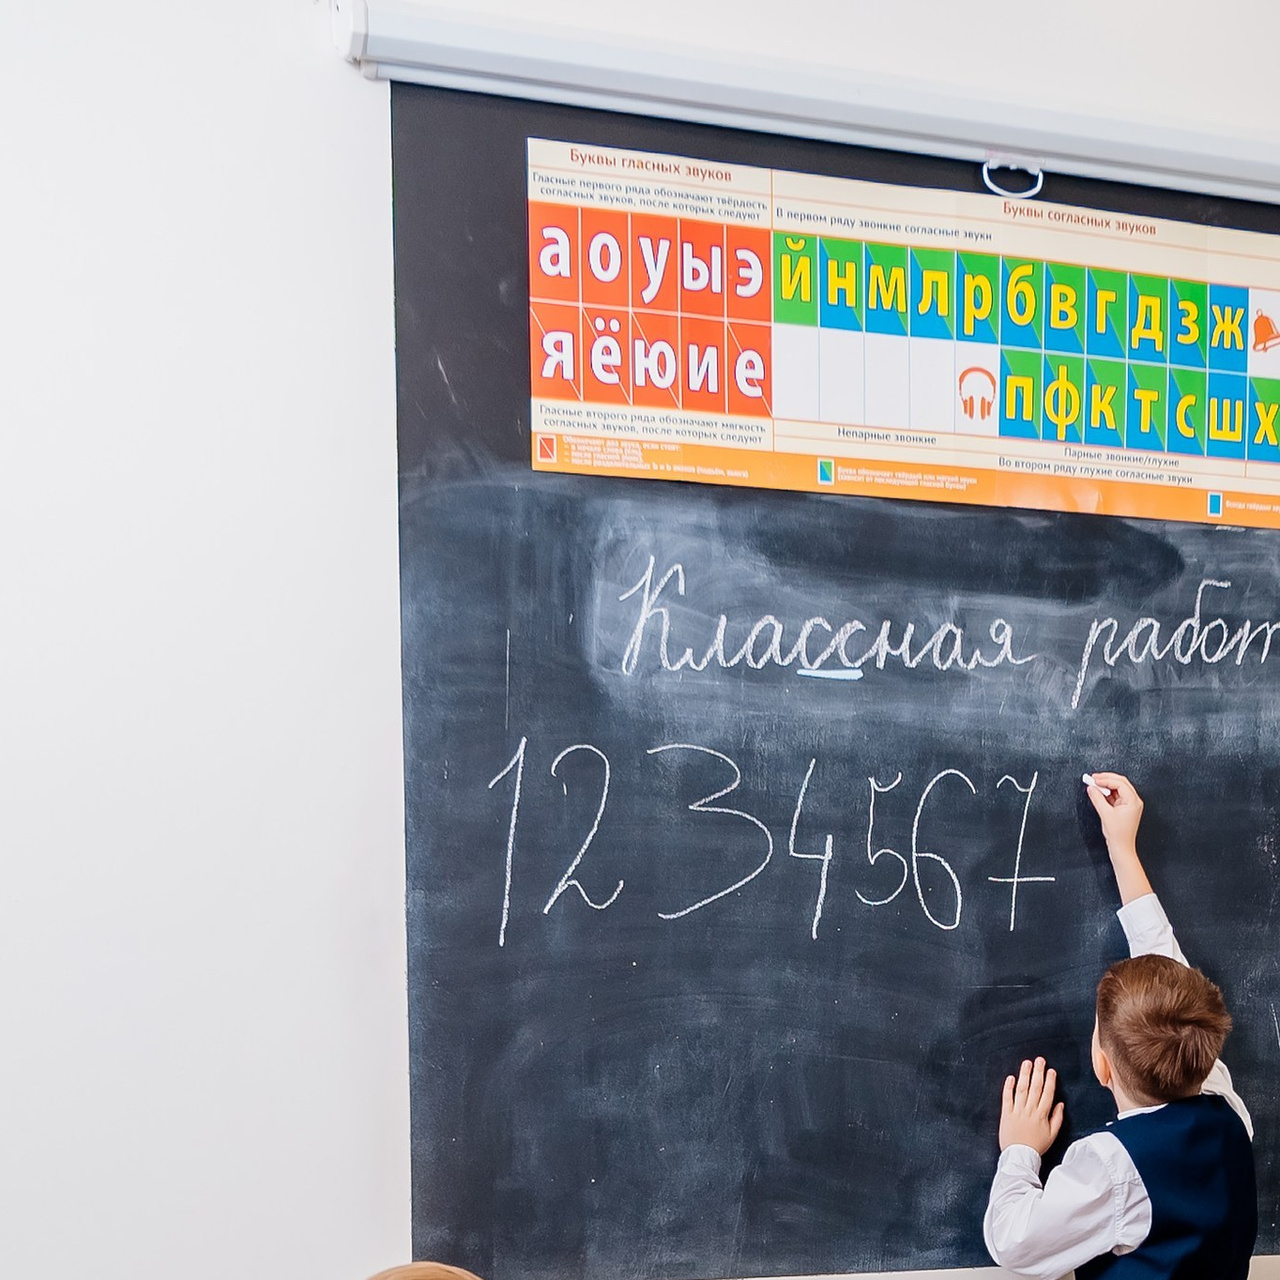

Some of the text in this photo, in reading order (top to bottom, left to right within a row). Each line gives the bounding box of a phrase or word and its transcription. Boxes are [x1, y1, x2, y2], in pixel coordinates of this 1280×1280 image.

[570, 148, 732, 182] Буквы гласных звуков
[532, 172, 768, 211] Гласные первого ряда обозначают твёрдость
[540, 186, 760, 222] согласных звуков, после которых следуют
[776, 207, 993, 242] В первом ряду звонкие согласные звуки
[1003, 201, 1157, 237] Буквы согласных звуков
[539, 405, 766, 434] Гласные второго ряда обозначают мягкость
[544, 417, 762, 446] согласных звуков, после которых следуют
[837, 427, 937, 445] Непарные звонкие
[998, 456, 1193, 486] Во втором ряду глухие согласные звуки
[1064, 447, 1180, 469] Парные звонкие/глухие
[618, 554, 1036, 675] Классная
